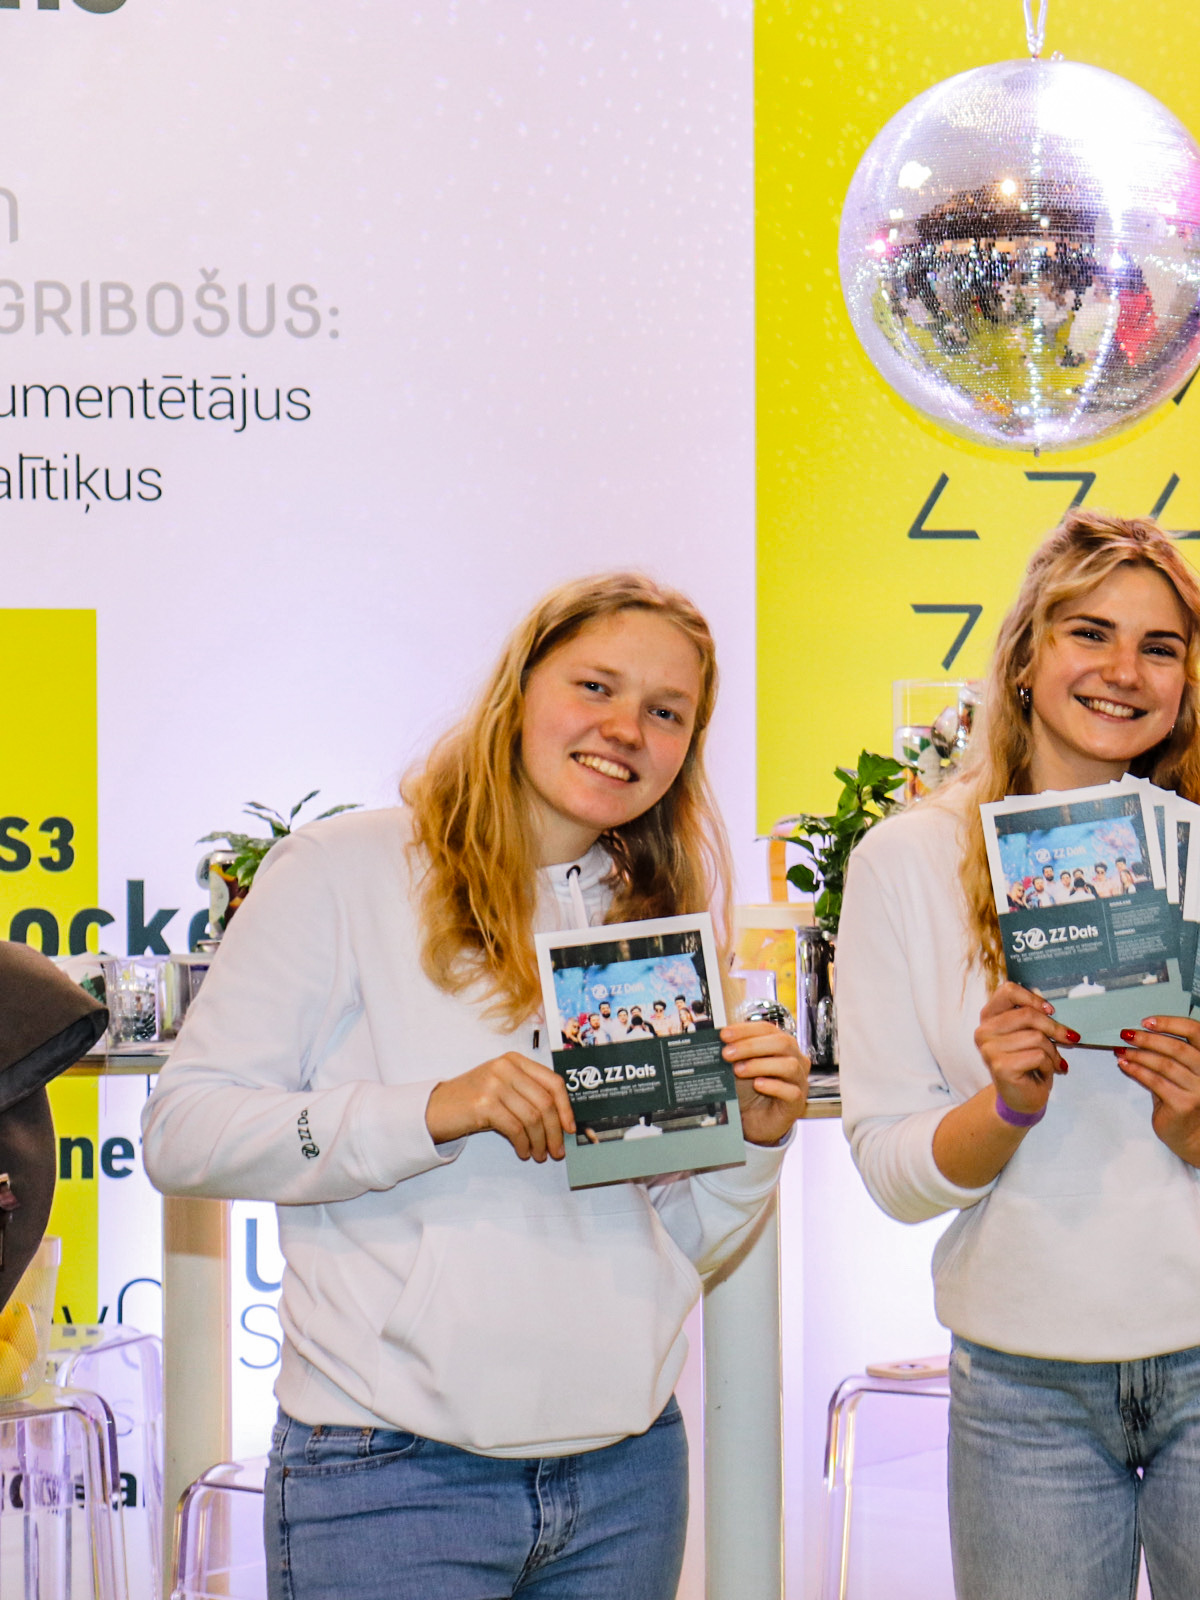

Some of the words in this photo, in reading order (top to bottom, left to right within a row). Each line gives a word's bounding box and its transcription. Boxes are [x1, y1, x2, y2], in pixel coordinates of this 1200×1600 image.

[0, 267, 340, 341] GRIBOŠUS:
[1049, 926, 1068, 943] ZZ
[1068, 924, 1099, 941] Dats
[604, 1065, 624, 1084] ZZ
[625, 1063, 657, 1081] Dats
[59, 1136, 143, 1179] ne
